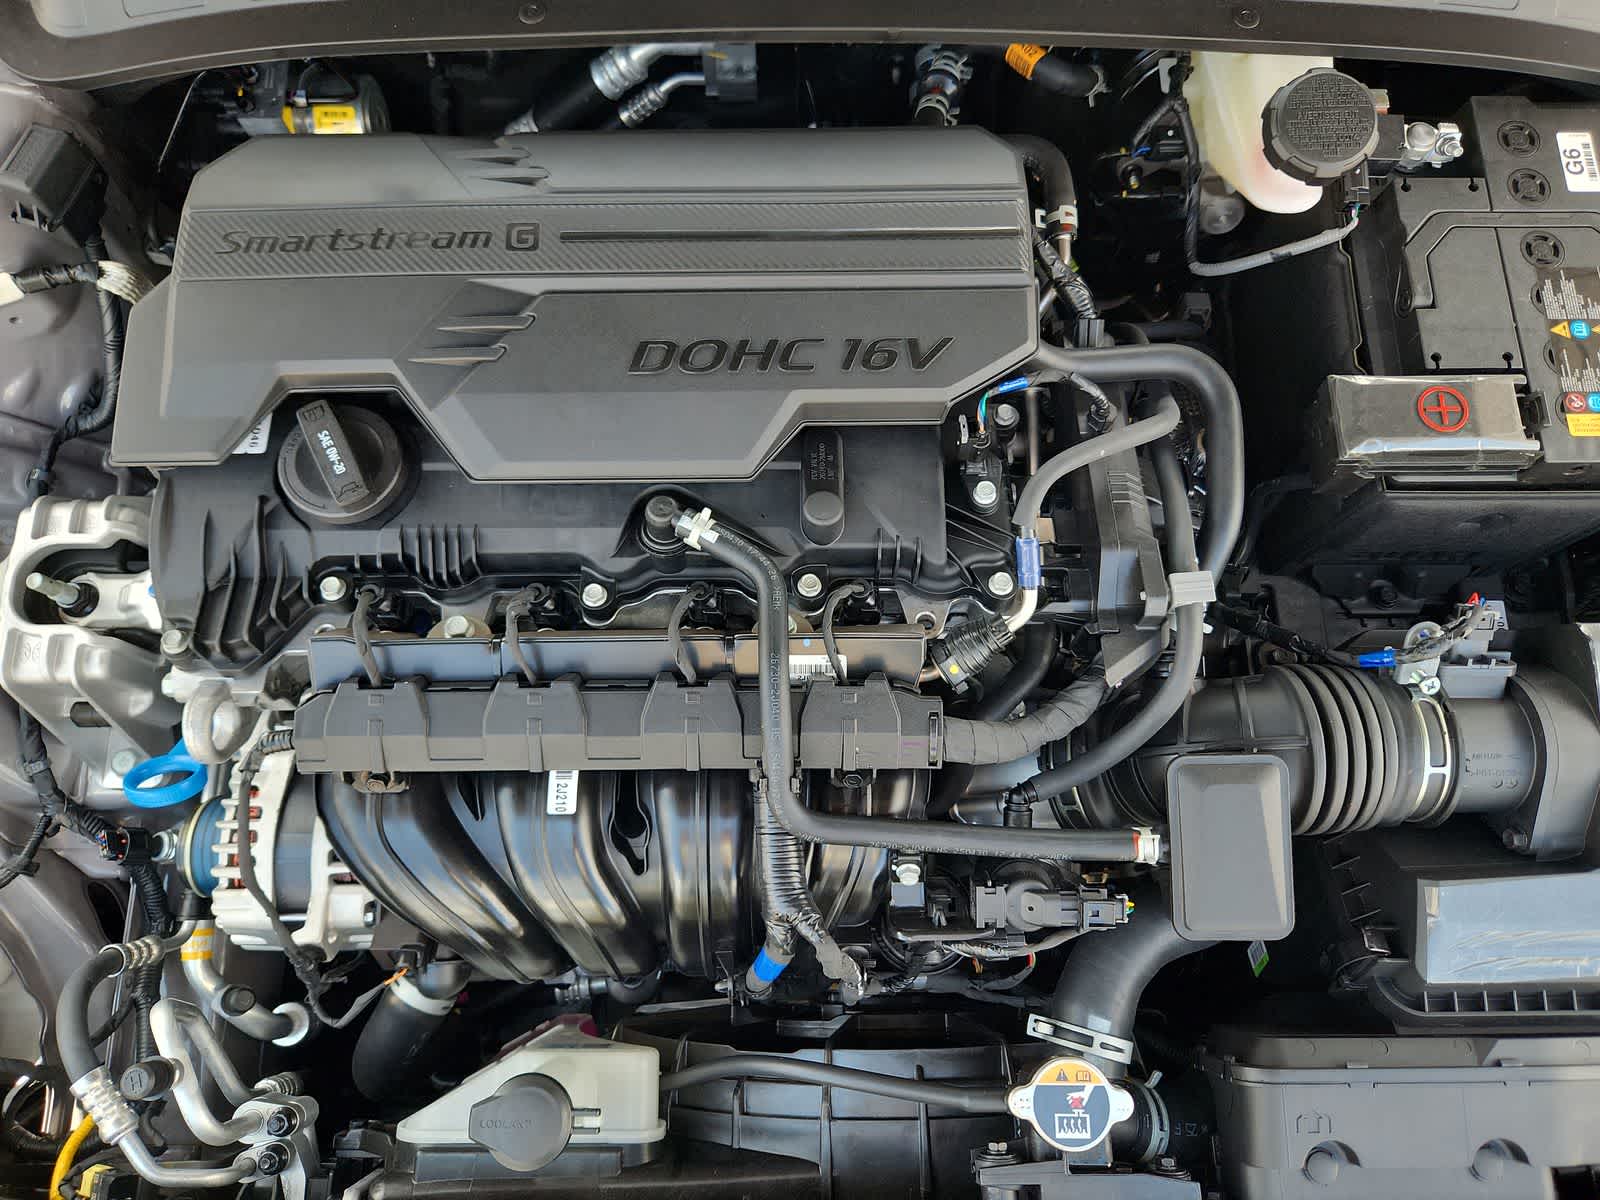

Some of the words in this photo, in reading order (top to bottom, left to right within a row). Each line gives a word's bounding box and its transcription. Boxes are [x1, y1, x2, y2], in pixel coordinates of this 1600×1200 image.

[1563, 148, 1585, 175] G6
[215, 227, 492, 254] Smartstream
[508, 224, 537, 250] G
[627, 338, 824, 375] DOHC
[840, 336, 955, 373] 16V
[317, 430, 334, 449] SAE
[325, 447, 346, 475] 0W-20
[555, 782, 569, 813] 2J210
